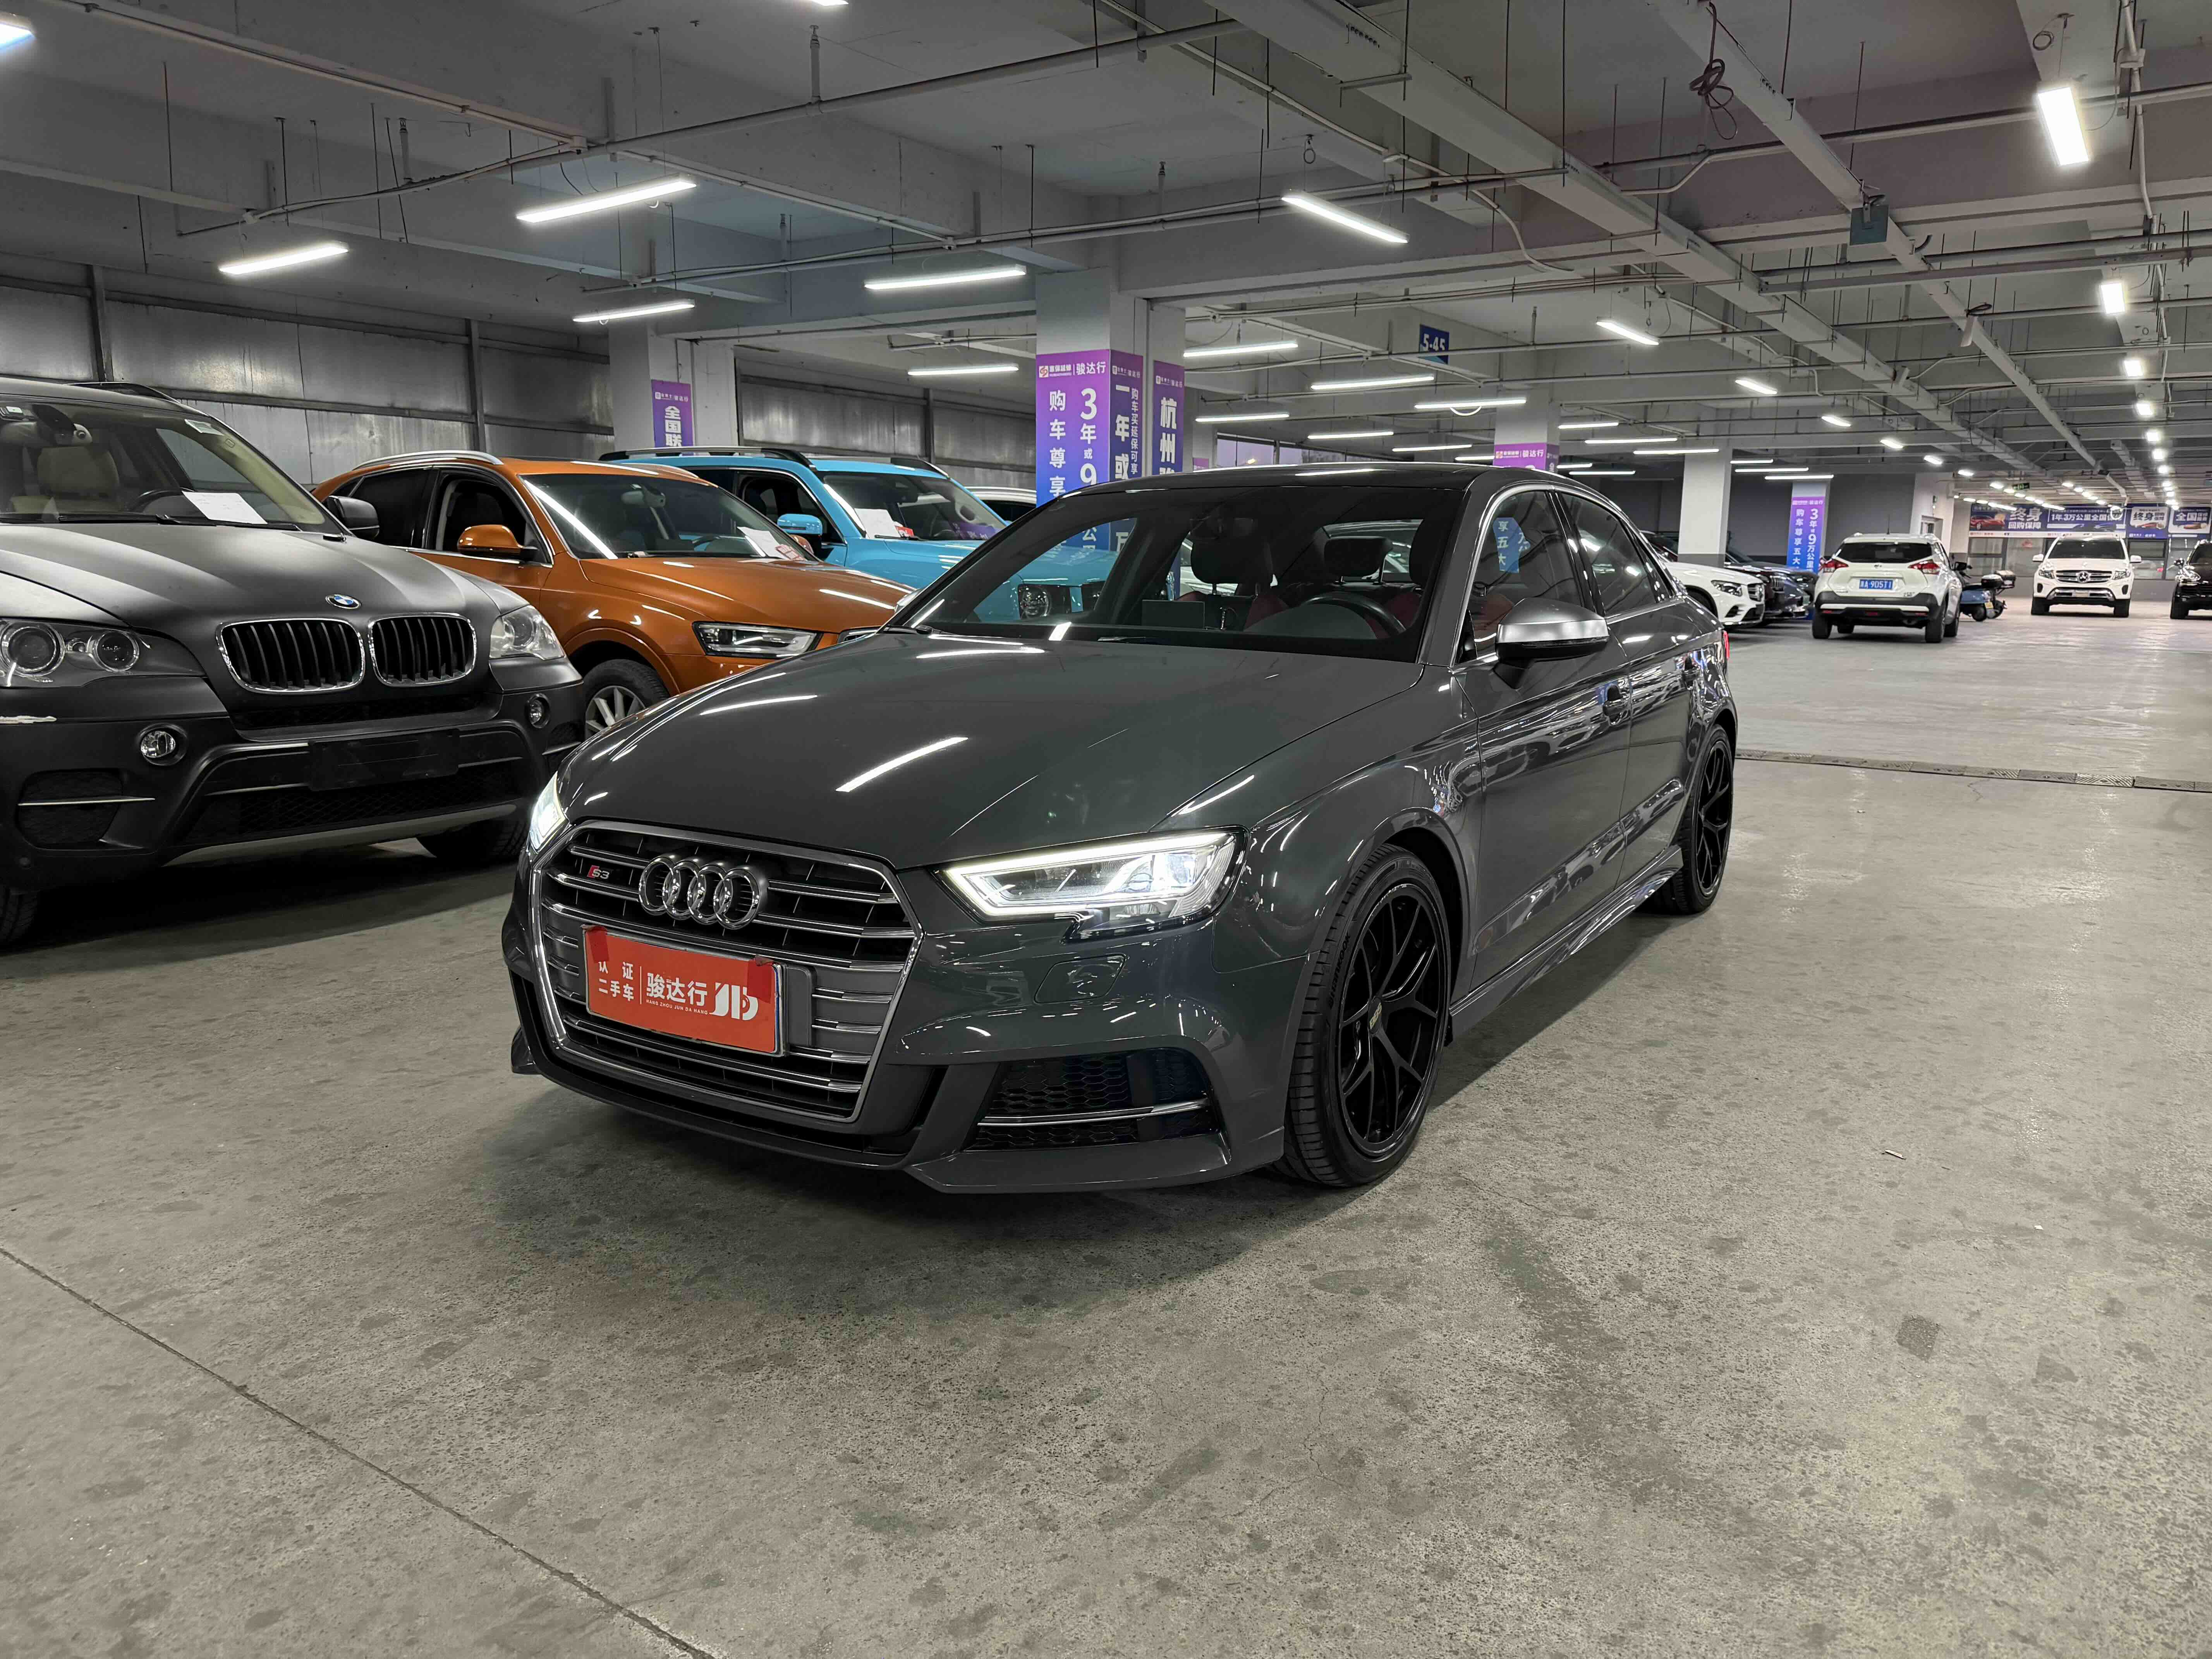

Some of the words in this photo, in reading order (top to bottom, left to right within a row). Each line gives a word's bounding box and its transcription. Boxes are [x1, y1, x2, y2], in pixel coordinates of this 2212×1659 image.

[1076, 361, 1106, 375] 骏达行
[665, 406, 682, 447] 全国联
[1049, 390, 1066, 497] 购车尊享
[1497, 521, 1509, 571] 享五大
[1792, 508, 1805, 568] 购车尊享五大
[1806, 508, 1819, 570] 3年或9万公里
[592, 869, 610, 879] S3
[599, 978, 634, 1001] 二手车
[646, 972, 708, 1006] 骏达行
